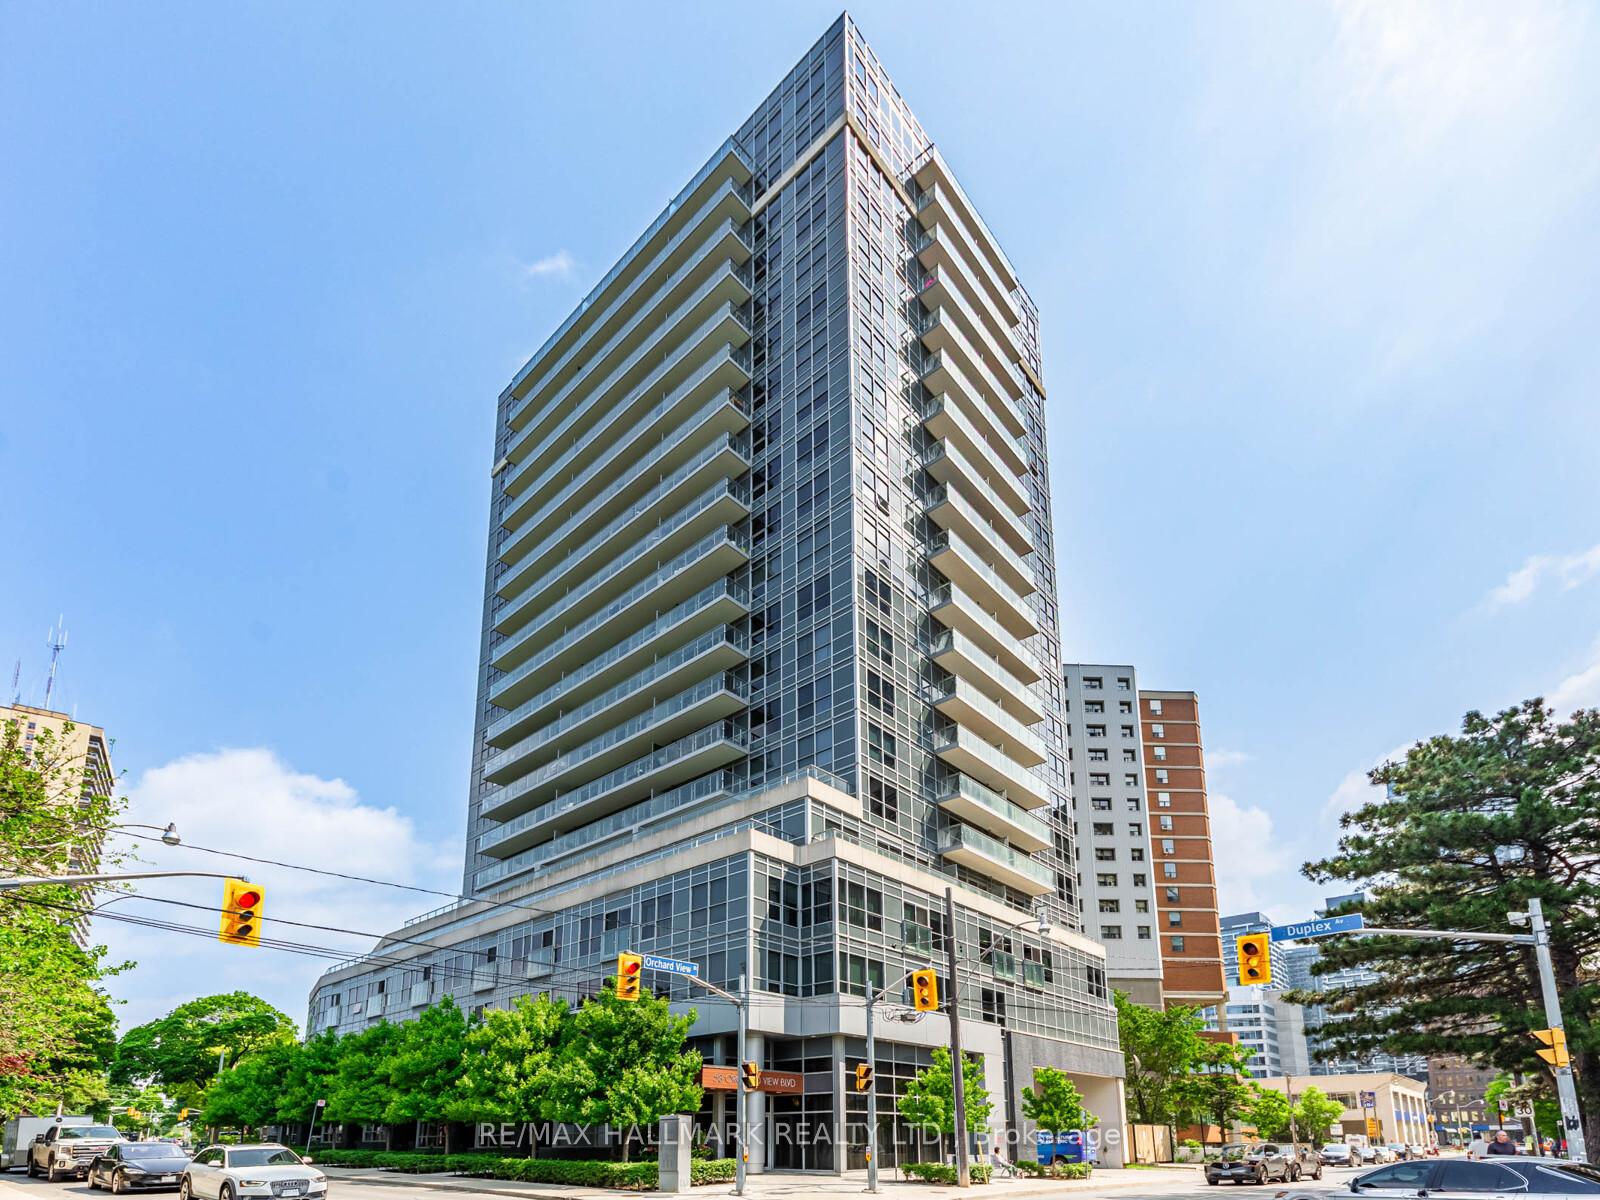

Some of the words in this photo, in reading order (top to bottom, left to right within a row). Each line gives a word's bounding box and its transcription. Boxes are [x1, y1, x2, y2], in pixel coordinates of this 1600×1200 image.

[1287, 920, 1331, 936] Duplex
[645, 957, 674, 971] Orchard
[675, 962, 692, 973] View
[763, 1077, 779, 1087] VIEW
[780, 1078, 796, 1088] BLVD
[1516, 1106, 1532, 1115] 30
